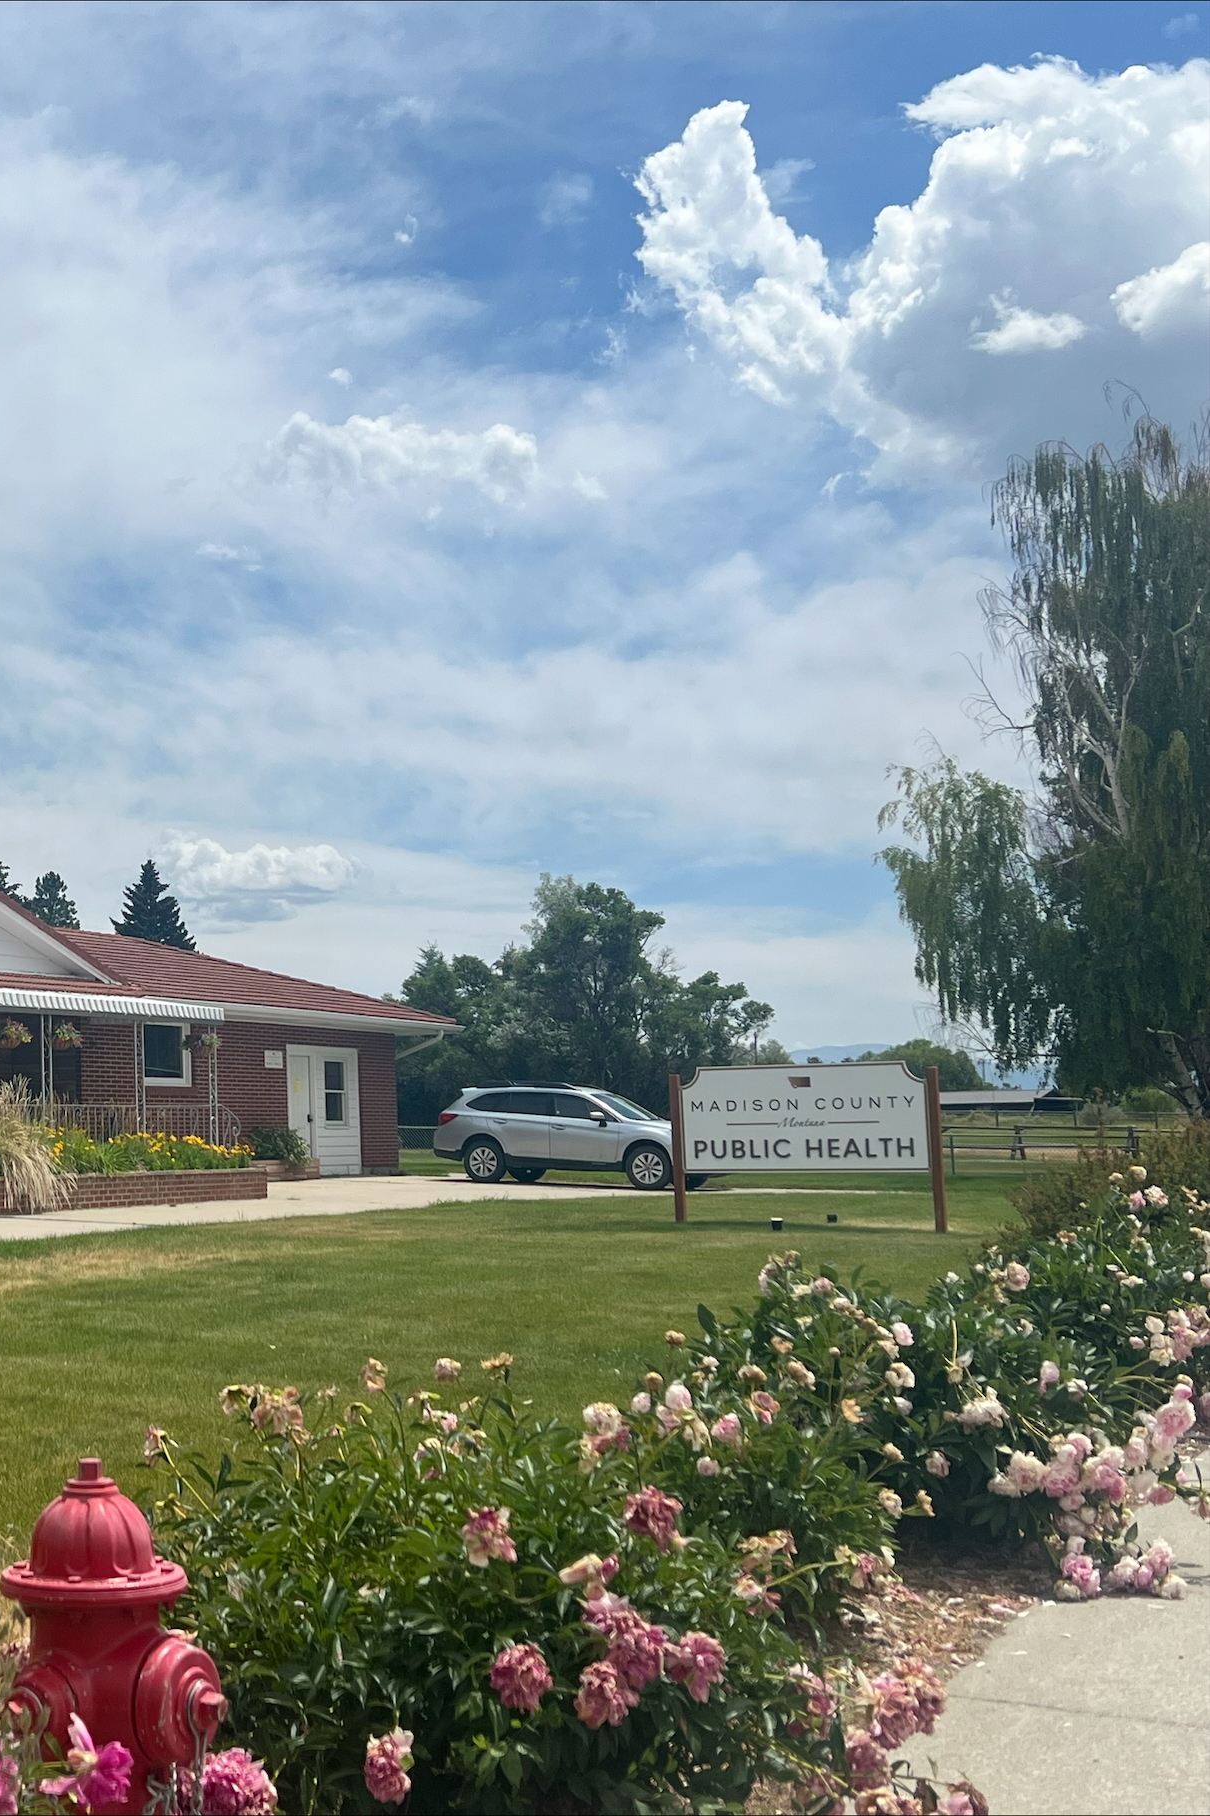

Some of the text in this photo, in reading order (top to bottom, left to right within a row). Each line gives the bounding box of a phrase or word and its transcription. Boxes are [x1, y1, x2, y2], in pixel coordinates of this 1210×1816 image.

[691, 1095, 915, 1113] MADISON COUNTY
[777, 1116, 827, 1129] Montana
[694, 1137, 915, 1160] PUBLIC HEALTH
